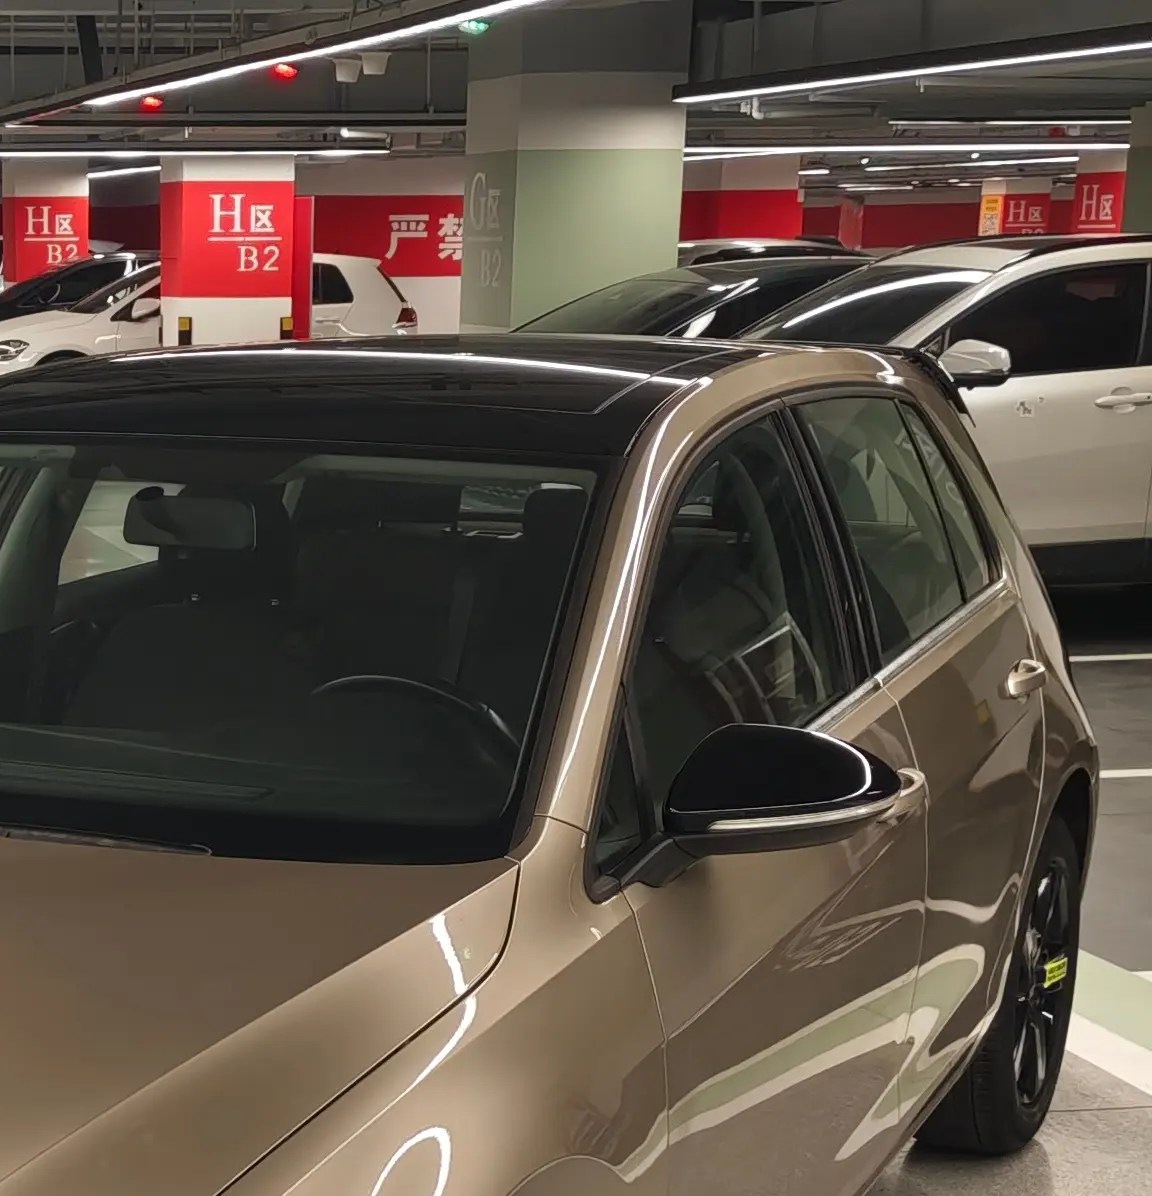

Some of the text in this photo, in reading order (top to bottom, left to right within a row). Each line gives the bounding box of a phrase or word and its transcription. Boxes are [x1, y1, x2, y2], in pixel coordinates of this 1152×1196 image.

[208, 193, 276, 234] H区
[469, 171, 502, 231] G区
[1007, 200, 1043, 223] H区
[1078, 184, 1115, 222] H区
[24, 206, 75, 236] H区
[46, 243, 80, 266] B2
[236, 244, 281, 273] B2
[480, 247, 502, 288] B2
